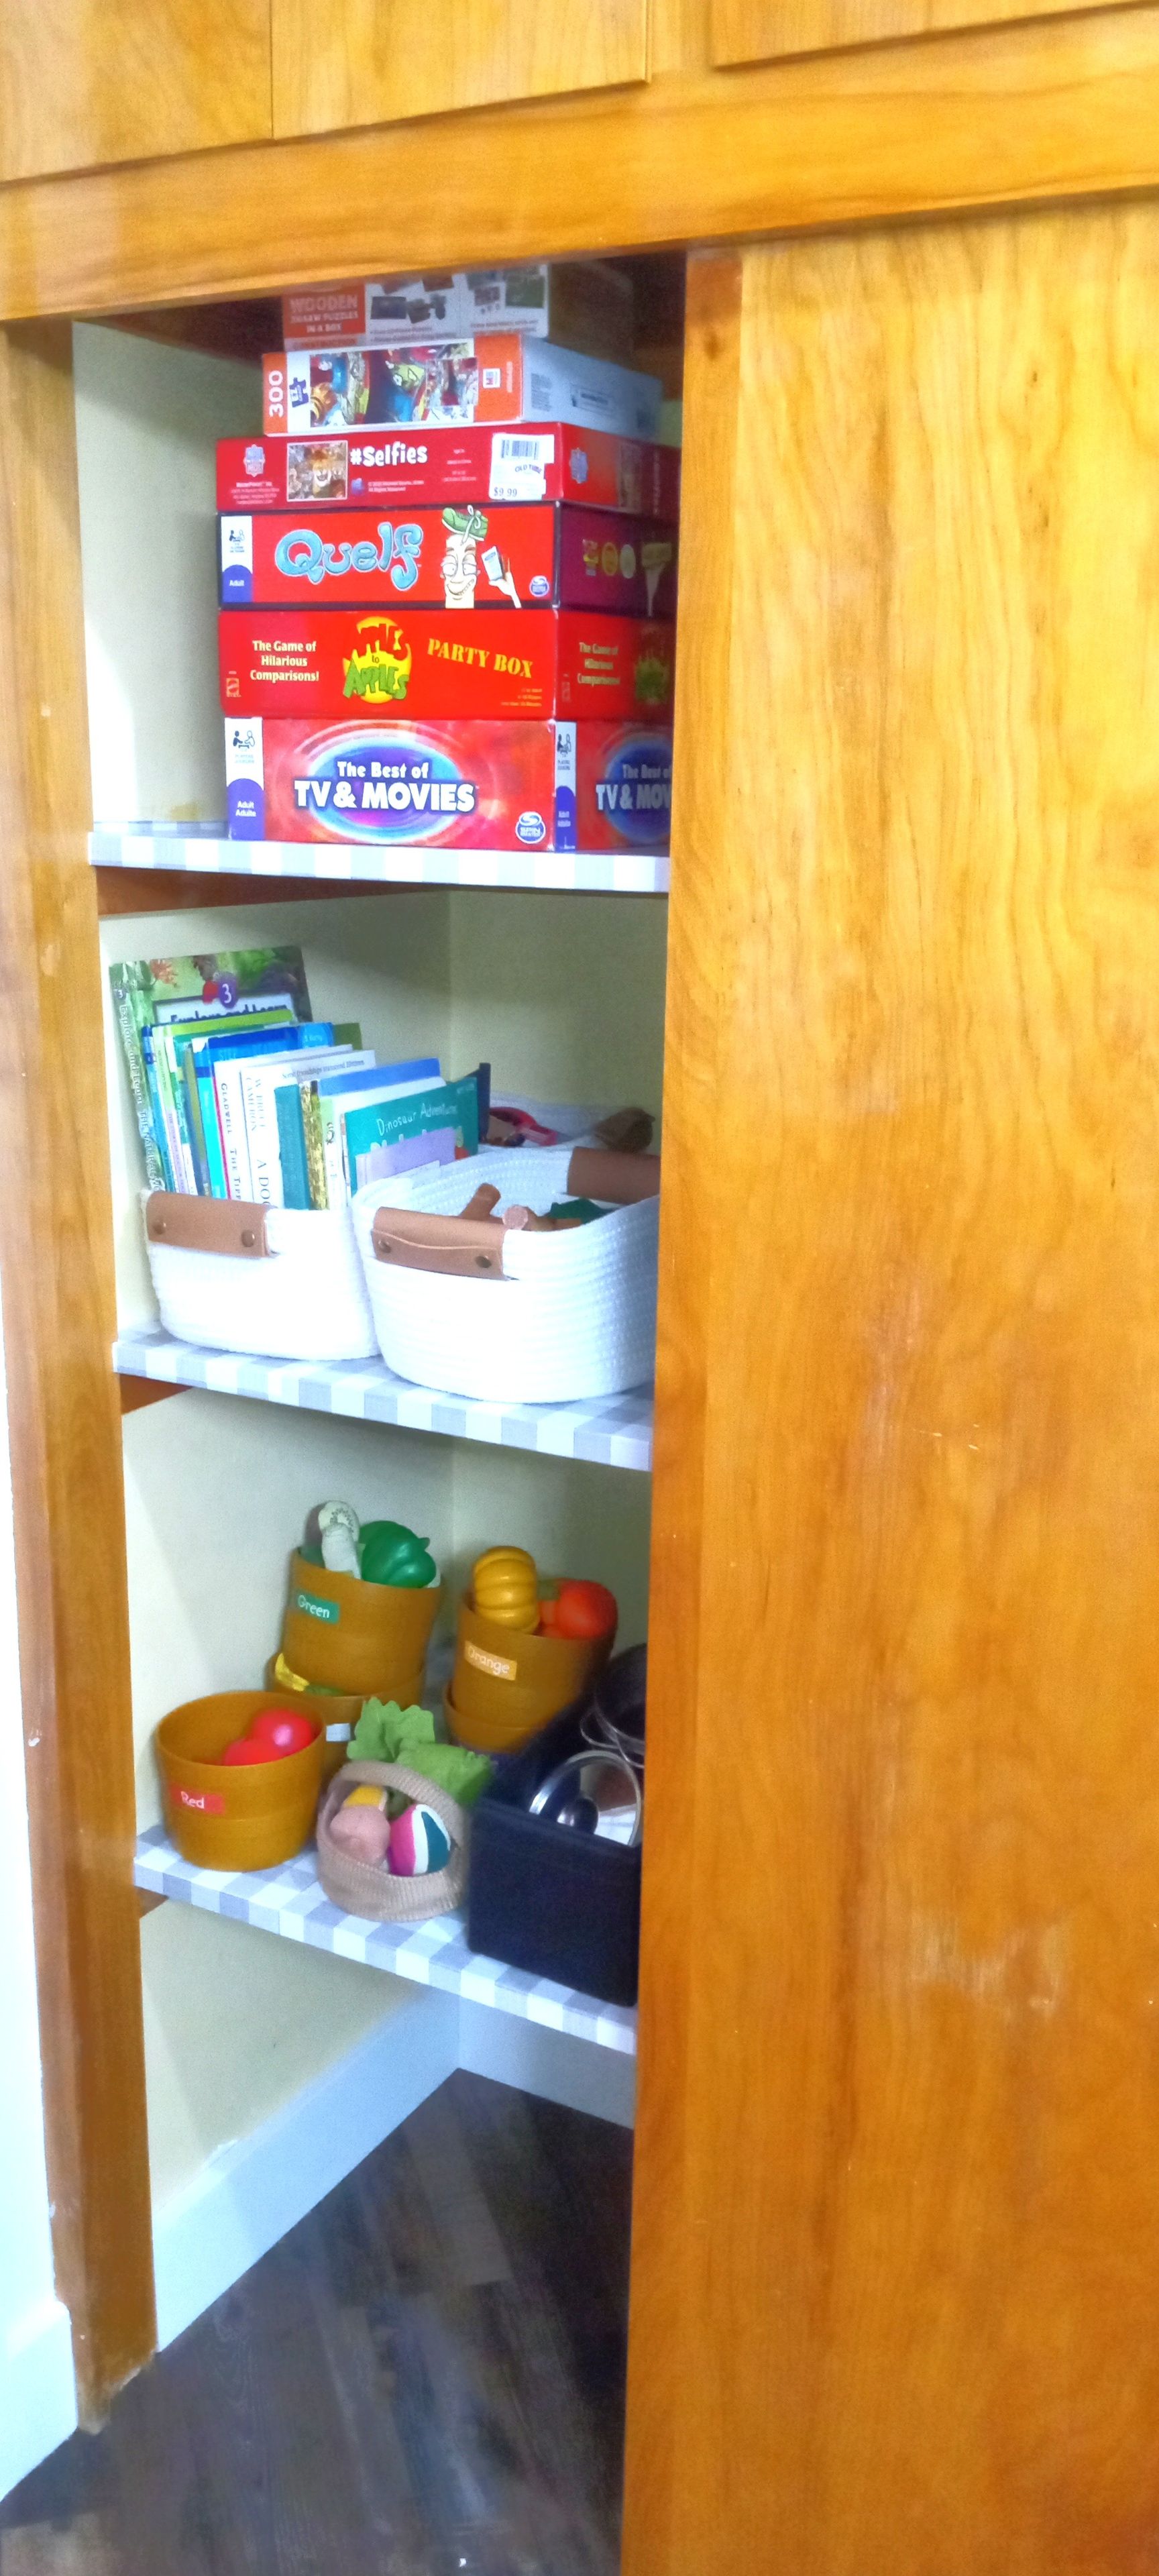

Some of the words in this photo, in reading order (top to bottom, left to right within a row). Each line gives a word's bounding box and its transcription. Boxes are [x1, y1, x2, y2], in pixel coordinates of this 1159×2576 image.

[289, 295, 357, 313] WOODEN
[269, 370, 284, 417] 300
[350, 441, 428, 467] #Selfies
[275, 521, 424, 591] Quelf
[252, 640, 272, 652] The
[274, 641, 304, 652] Game
[305, 641, 317, 652] of
[261, 655, 308, 667] Hilarious
[372, 654, 380, 664] to
[427, 637, 490, 668] PARTY
[493, 653, 534, 679] BOX
[250, 669, 320, 684] Comparisons!
[343, 663, 410, 700] APPLES
[337, 761, 366, 777] The
[371, 762, 407, 778] Best
[411, 762, 429, 779] of
[622, 763, 639, 778] The
[237, 801, 255, 809] Adult
[294, 780, 331, 807] TV
[333, 781, 357, 808] &
[362, 782, 475, 812] MOVIES
[596, 784, 618, 810] TV
[620, 784, 633, 810] &
[222, 983, 232, 1004] 3
[221, 1083, 233, 1134] GLADWELL
[376, 1110, 417, 1137] Dinosaur
[230, 1148, 238, 1171] THE
[257, 1159, 267, 1169] A
[298, 1595, 330, 1619] Green
[467, 1646, 510, 1676] Orange
[180, 1790, 205, 1809] Red
